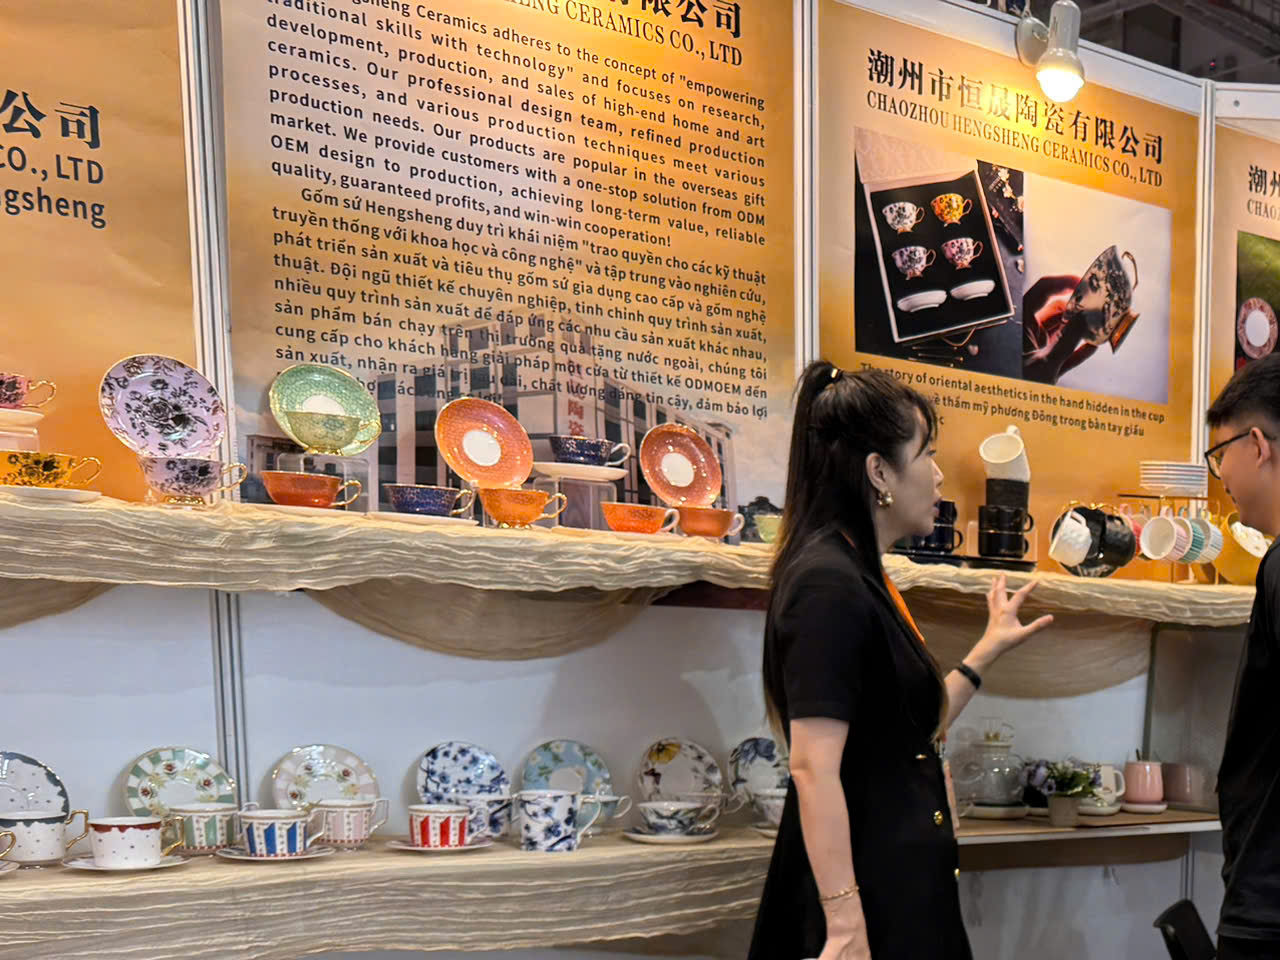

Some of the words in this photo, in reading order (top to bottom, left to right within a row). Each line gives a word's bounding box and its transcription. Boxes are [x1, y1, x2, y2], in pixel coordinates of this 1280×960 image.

[266, 13, 389, 58] development,
[398, 48, 492, 83] production,
[501, 74, 528, 89] and
[537, 83, 574, 100] sales
[582, 93, 596, 106] of
[603, 96, 665, 123] high-end
[672, 113, 709, 134] home
[715, 127, 739, 141] and
[746, 135, 764, 148] art
[267, 0, 367, 26] aditional
[376, 19, 421, 40] skills
[431, 33, 467, 52] with
[476, 43, 573, 79] technology"
[582, 73, 608, 88] and
[616, 78, 670, 104] focuses
[678, 98, 694, 110] on
[702, 104, 764, 130] research,
[416, 5, 487, 34] Ceramics
[492, 27, 551, 51] adheres
[557, 42, 570, 56] to
[576, 47, 598, 64] the
[604, 57, 656, 80] concept
[661, 71, 674, 84] of
[679, 74, 764, 111] "empowering
[565, 0, 665, 45] CERAMICS
[669, 29, 705, 61] CO.,
[709, 40, 742, 67] LTD
[267, 40, 356, 71] ceramics.
[367, 61, 398, 80] Our
[408, 73, 512, 108] professional
[521, 98, 571, 123] design
[580, 113, 622, 137] team,
[630, 127, 681, 148] refined
[689, 141, 764, 167] production
[269, 64, 366, 99] processes,
[376, 89, 407, 106] and
[416, 98, 478, 122] various
[488, 115, 575, 144] production
[583, 136, 665, 164] techniques
[673, 158, 707, 174] meet
[714, 167, 764, 187] various
[269, 88, 362, 119] production
[372, 112, 424, 132] needs.
[433, 123, 461, 140] Our
[469, 133, 535, 156] products
[542, 150, 565, 163] are
[573, 156, 627, 176] popular
[634, 166, 646, 181] in
[653, 171, 675, 187] the
[681, 180, 737, 200] overseas
[744, 192, 765, 207] gift
[867, 48, 1162, 164] 潮州市恒晟陶瓷有限公司
[867, 89, 946, 128] CHAOZHOU
[953, 116, 1039, 152] HENGSHENG
[1042, 139, 1109, 172] CERAMICS
[1112, 159, 1137, 183] CO.,
[1139, 165, 1162, 187] LTD
[0, 186, 107, 229] gsheng
[56, 154, 104, 185] LTD
[270, 112, 336, 136] market.
[343, 125, 367, 143] We
[374, 135, 435, 157] provide
[441, 150, 519, 175] customers
[525, 166, 556, 183] with
[563, 175, 570, 186] a
[576, 178, 637, 202] one-stop
[642, 192, 696, 212] solution
[702, 201, 731, 219] from
[734, 209, 764, 226] ODM
[270, 134, 308, 154] OEM
[318, 144, 374, 168] design
[383, 158, 400, 172] to
[409, 165, 503, 197] production,
[511, 186, 583, 212] achieving
[591, 199, 660, 225] long-term
[667, 217, 708, 237] value,
[715, 226, 765, 245] reliable
[271, 161, 337, 186] quality,
[340, 174, 431, 201] guaranteed
[435, 193, 490, 216] profits,
[493, 204, 520, 218] and
[524, 209, 581, 230] win-win
[584, 222, 670, 247] cooperation!
[301, 187, 338, 206] Gốm
[342, 195, 362, 210] sứ
[365, 199, 452, 231] Hengsheng
[456, 216, 483, 236] duy
[486, 222, 503, 237] trì
[508, 225, 539, 243] khái
[543, 233, 578, 250] niệm
[582, 239, 618, 257] "trao
[915, 371, 927, 384] of
[928, 375, 972, 391] oriental
[974, 383, 1027, 401] aesthetics
[1029, 389, 1039, 402] in
[1040, 392, 1057, 406] the
[1059, 394, 1084, 410] hand
[1085, 398, 1119, 415] hidden
[1120, 404, 1129, 416] in
[1131, 407, 1146, 420] the
[1148, 412, 1164, 424] cup
